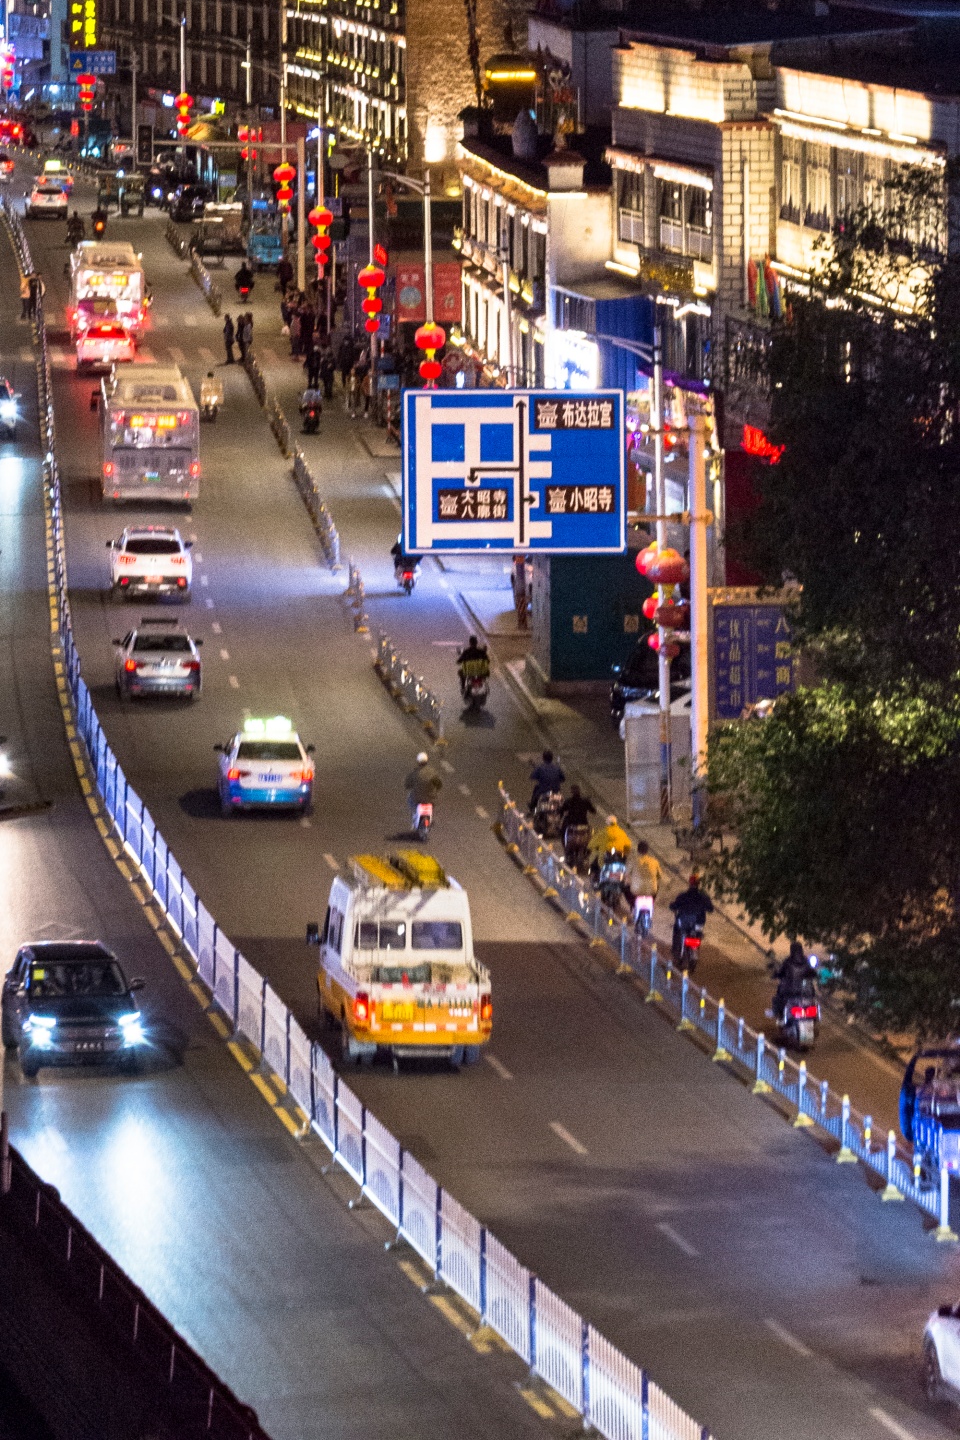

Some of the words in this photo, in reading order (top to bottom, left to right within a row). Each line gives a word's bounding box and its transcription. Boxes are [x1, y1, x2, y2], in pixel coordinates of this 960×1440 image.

[562, 401, 613, 427] 布达拉宫
[461, 489, 507, 504] 大昭寺
[570, 487, 612, 513] 小昭寺
[461, 504, 506, 519] 八廓街
